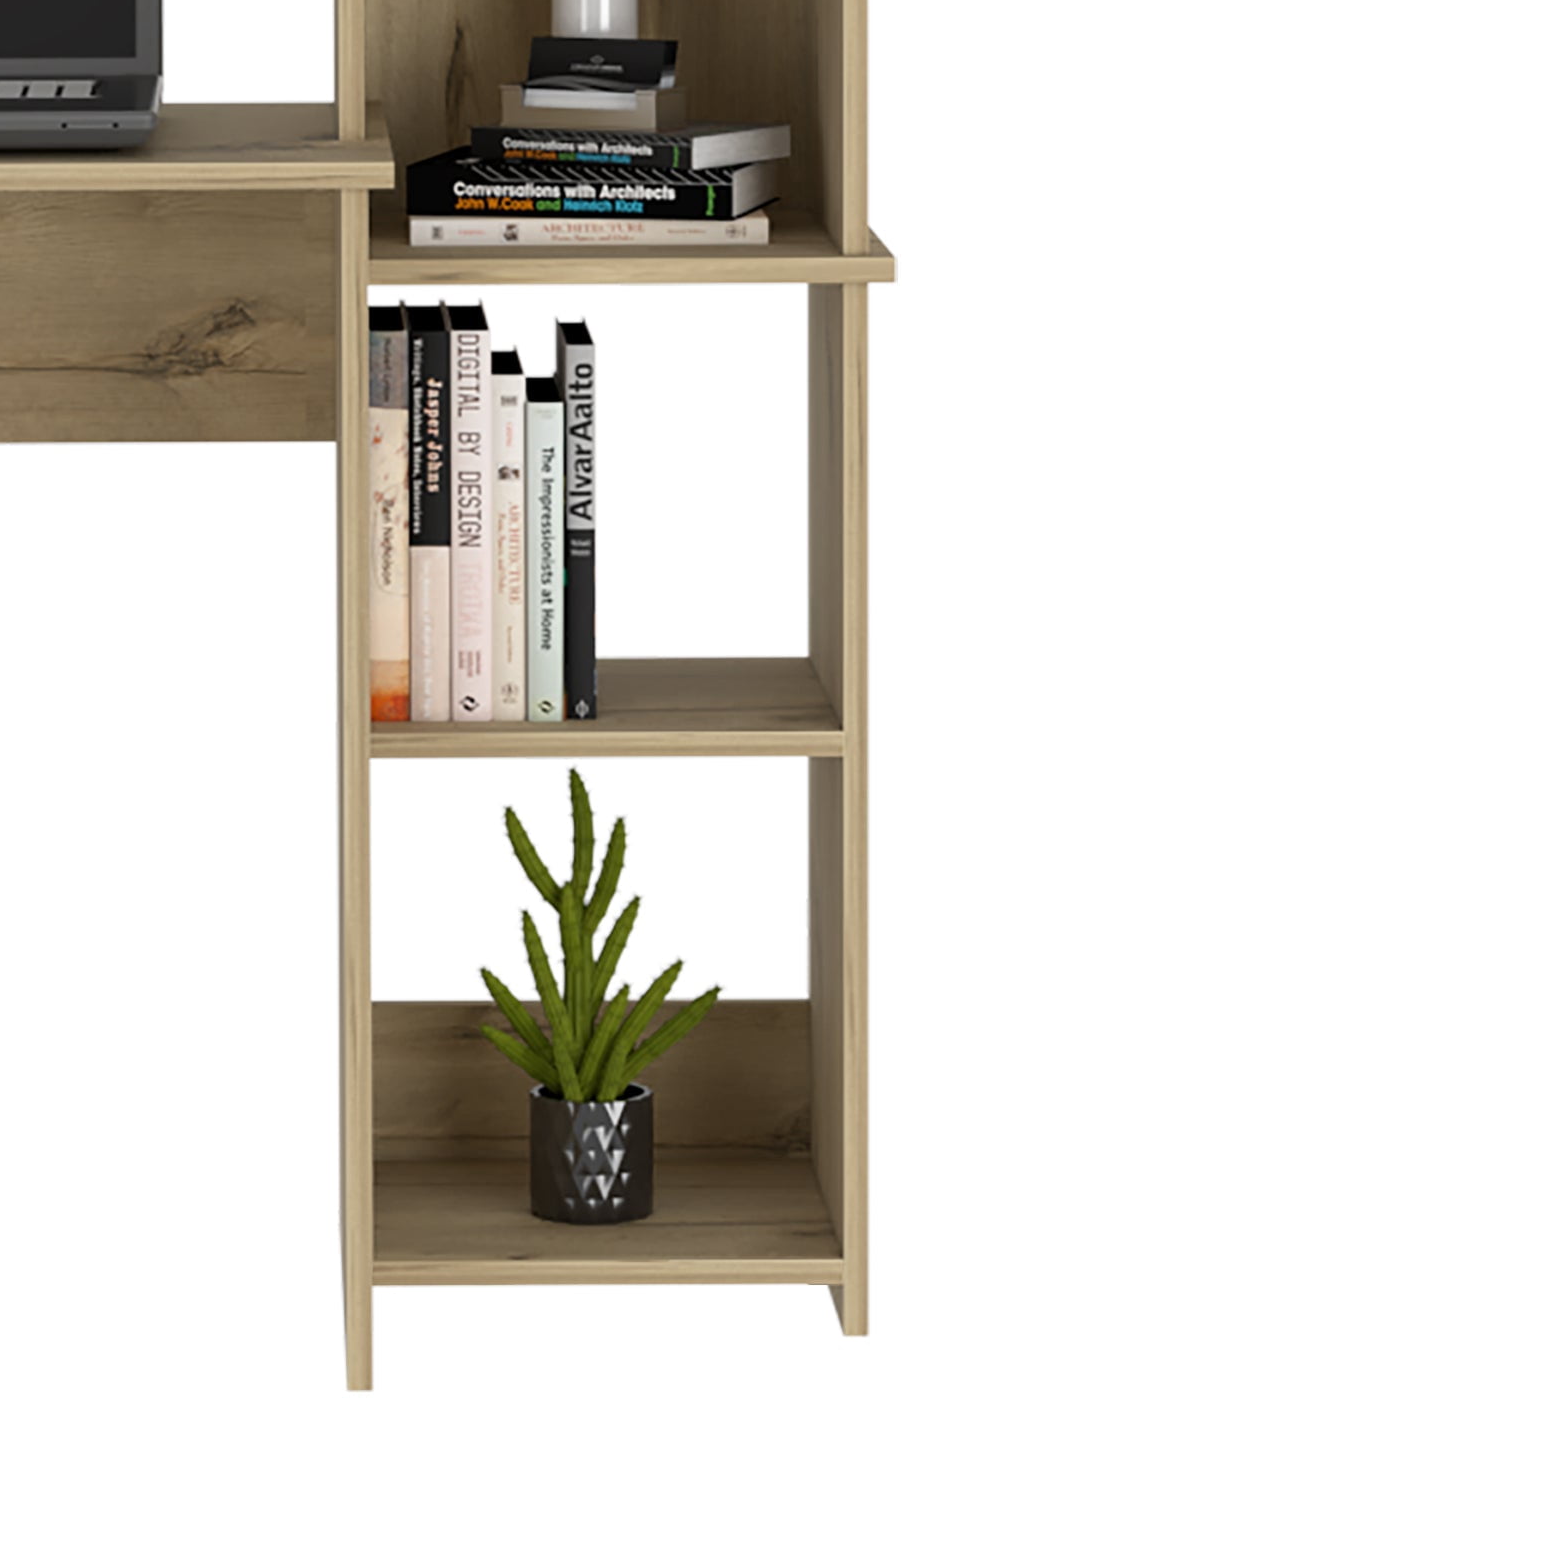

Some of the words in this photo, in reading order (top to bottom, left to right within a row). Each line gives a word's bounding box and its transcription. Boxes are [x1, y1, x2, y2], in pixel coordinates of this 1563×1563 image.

[453, 181, 560, 198] Conversations
[564, 185, 596, 199] with
[599, 185, 676, 200] Architects
[455, 197, 484, 210] John
[536, 199, 561, 211] and
[563, 199, 613, 212] Heinrich
[615, 200, 644, 213] Klotz
[458, 333, 481, 417] DIGITAL
[424, 377, 443, 435] Jasper
[569, 363, 593, 441] Aalto
[427, 441, 443, 493] Johns
[458, 432, 481, 456] BY
[541, 447, 555, 472] The
[569, 444, 593, 520] Alvar
[458, 471, 481, 548] DESIGN
[539, 478, 555, 586] Impressionists
[541, 590, 553, 604] at
[541, 609, 554, 651] Home
